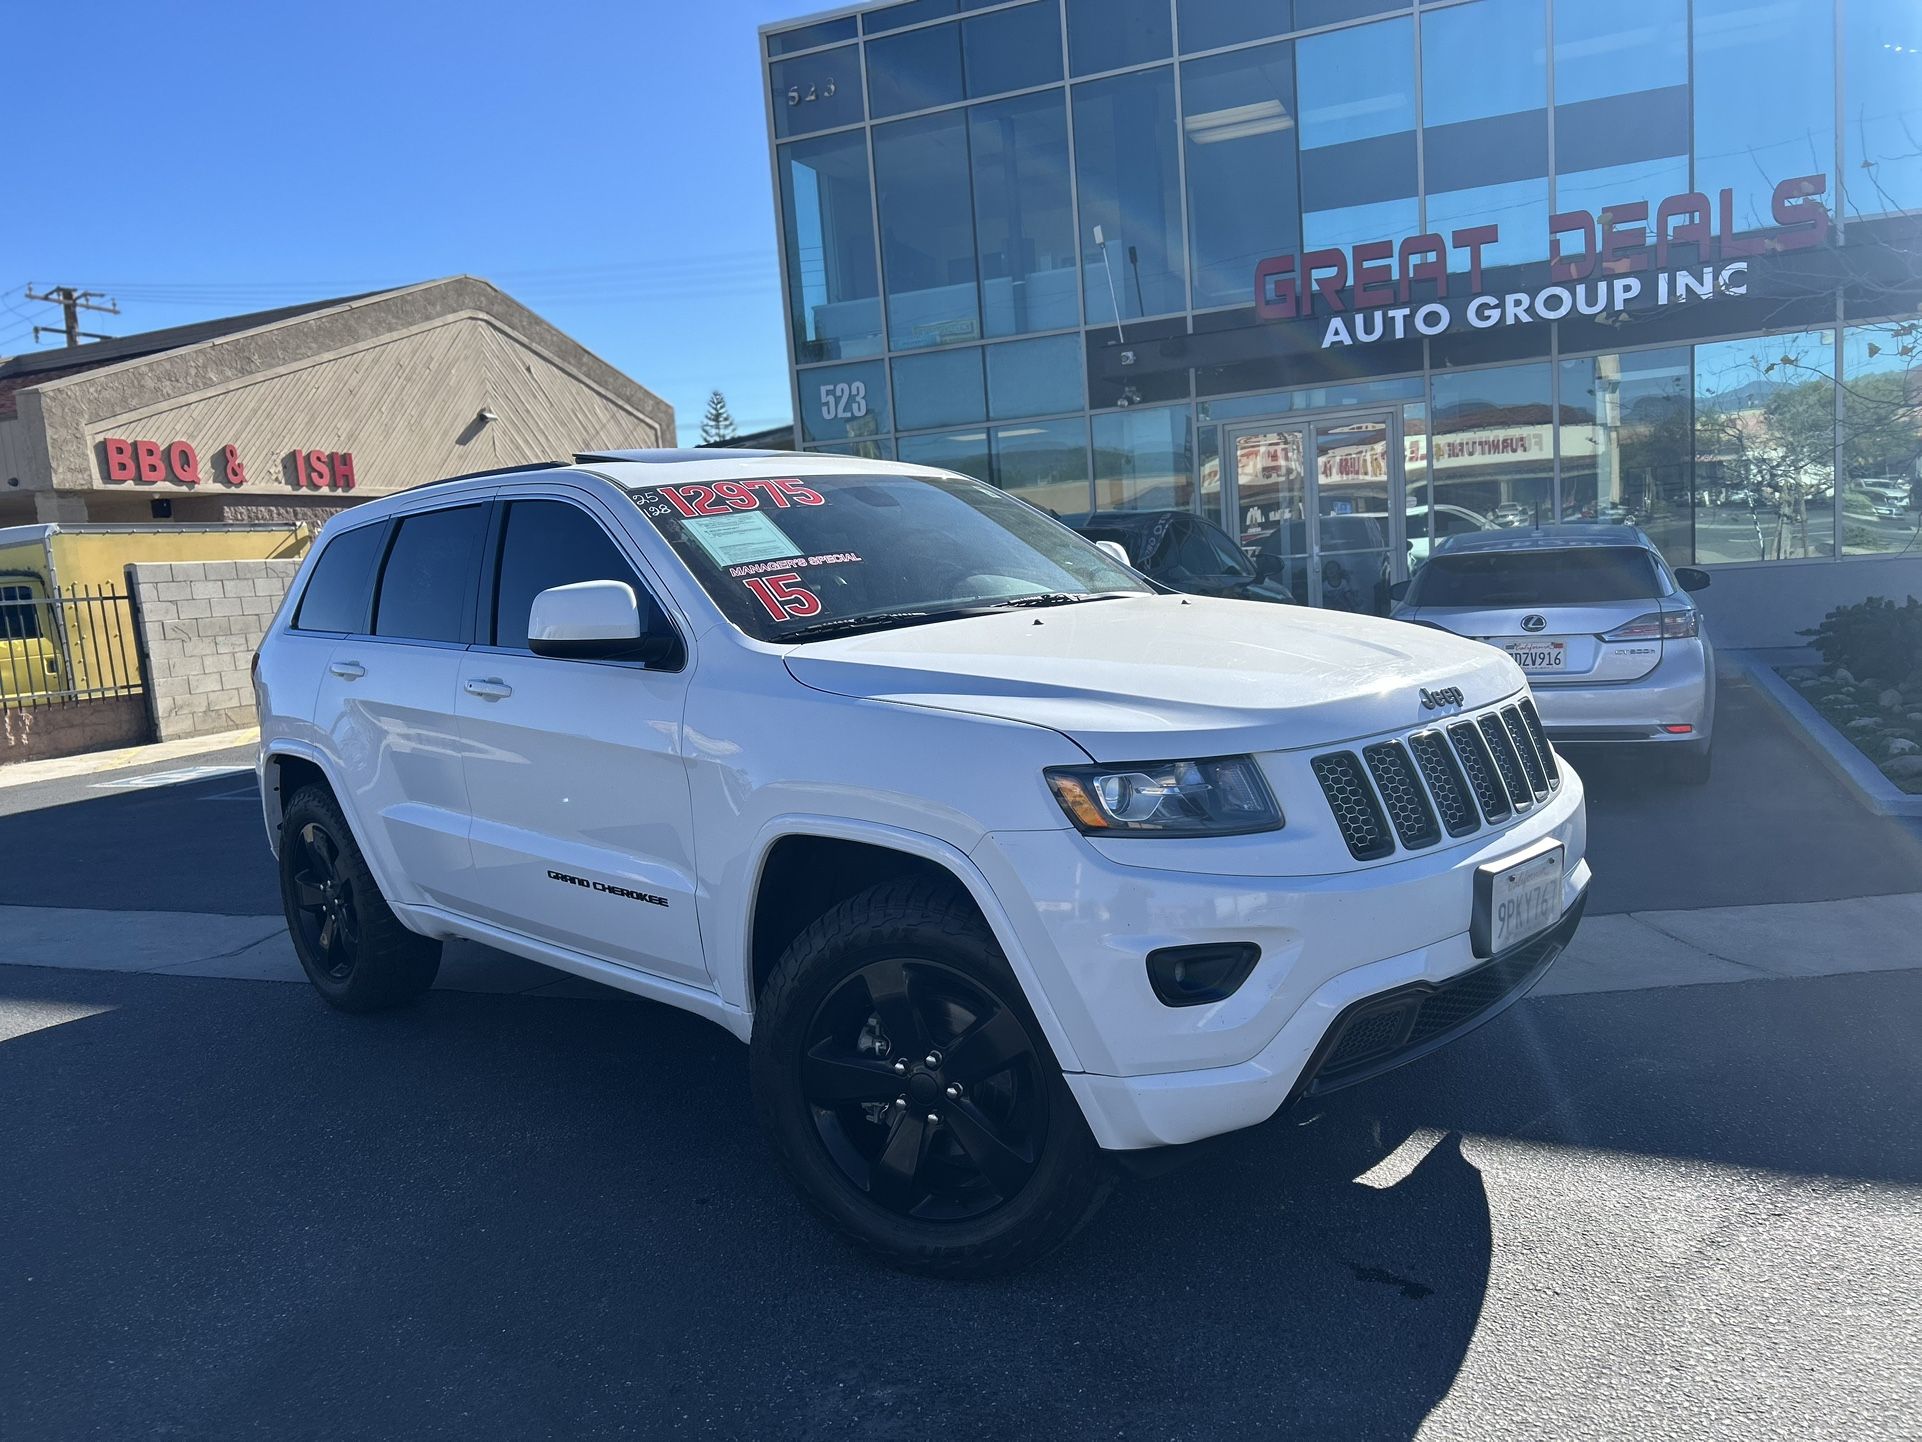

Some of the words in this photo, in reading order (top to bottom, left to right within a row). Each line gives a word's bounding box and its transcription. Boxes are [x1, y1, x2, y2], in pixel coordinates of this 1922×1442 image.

[1254, 223, 1499, 321] GREAT
[1550, 173, 1828, 283] DEALS
[1321, 302, 1451, 349] AUTO
[1466, 276, 1642, 329] GROUP
[1658, 261, 1749, 306] INC
[820, 381, 867, 420] 523
[104, 437, 201, 485] BBQ
[225, 443, 248, 484] &
[295, 448, 356, 488] ISH
[657, 478, 825, 518] 12975
[729, 558, 808, 577] MANAGER'S
[807, 552, 863, 566] SPECIAL
[742, 572, 822, 622] 15
[1509, 651, 1562, 667] DZV916
[1419, 686, 1465, 711] Jeep
[547, 869, 590, 889] GRAND
[592, 881, 670, 908] CHEROKEE
